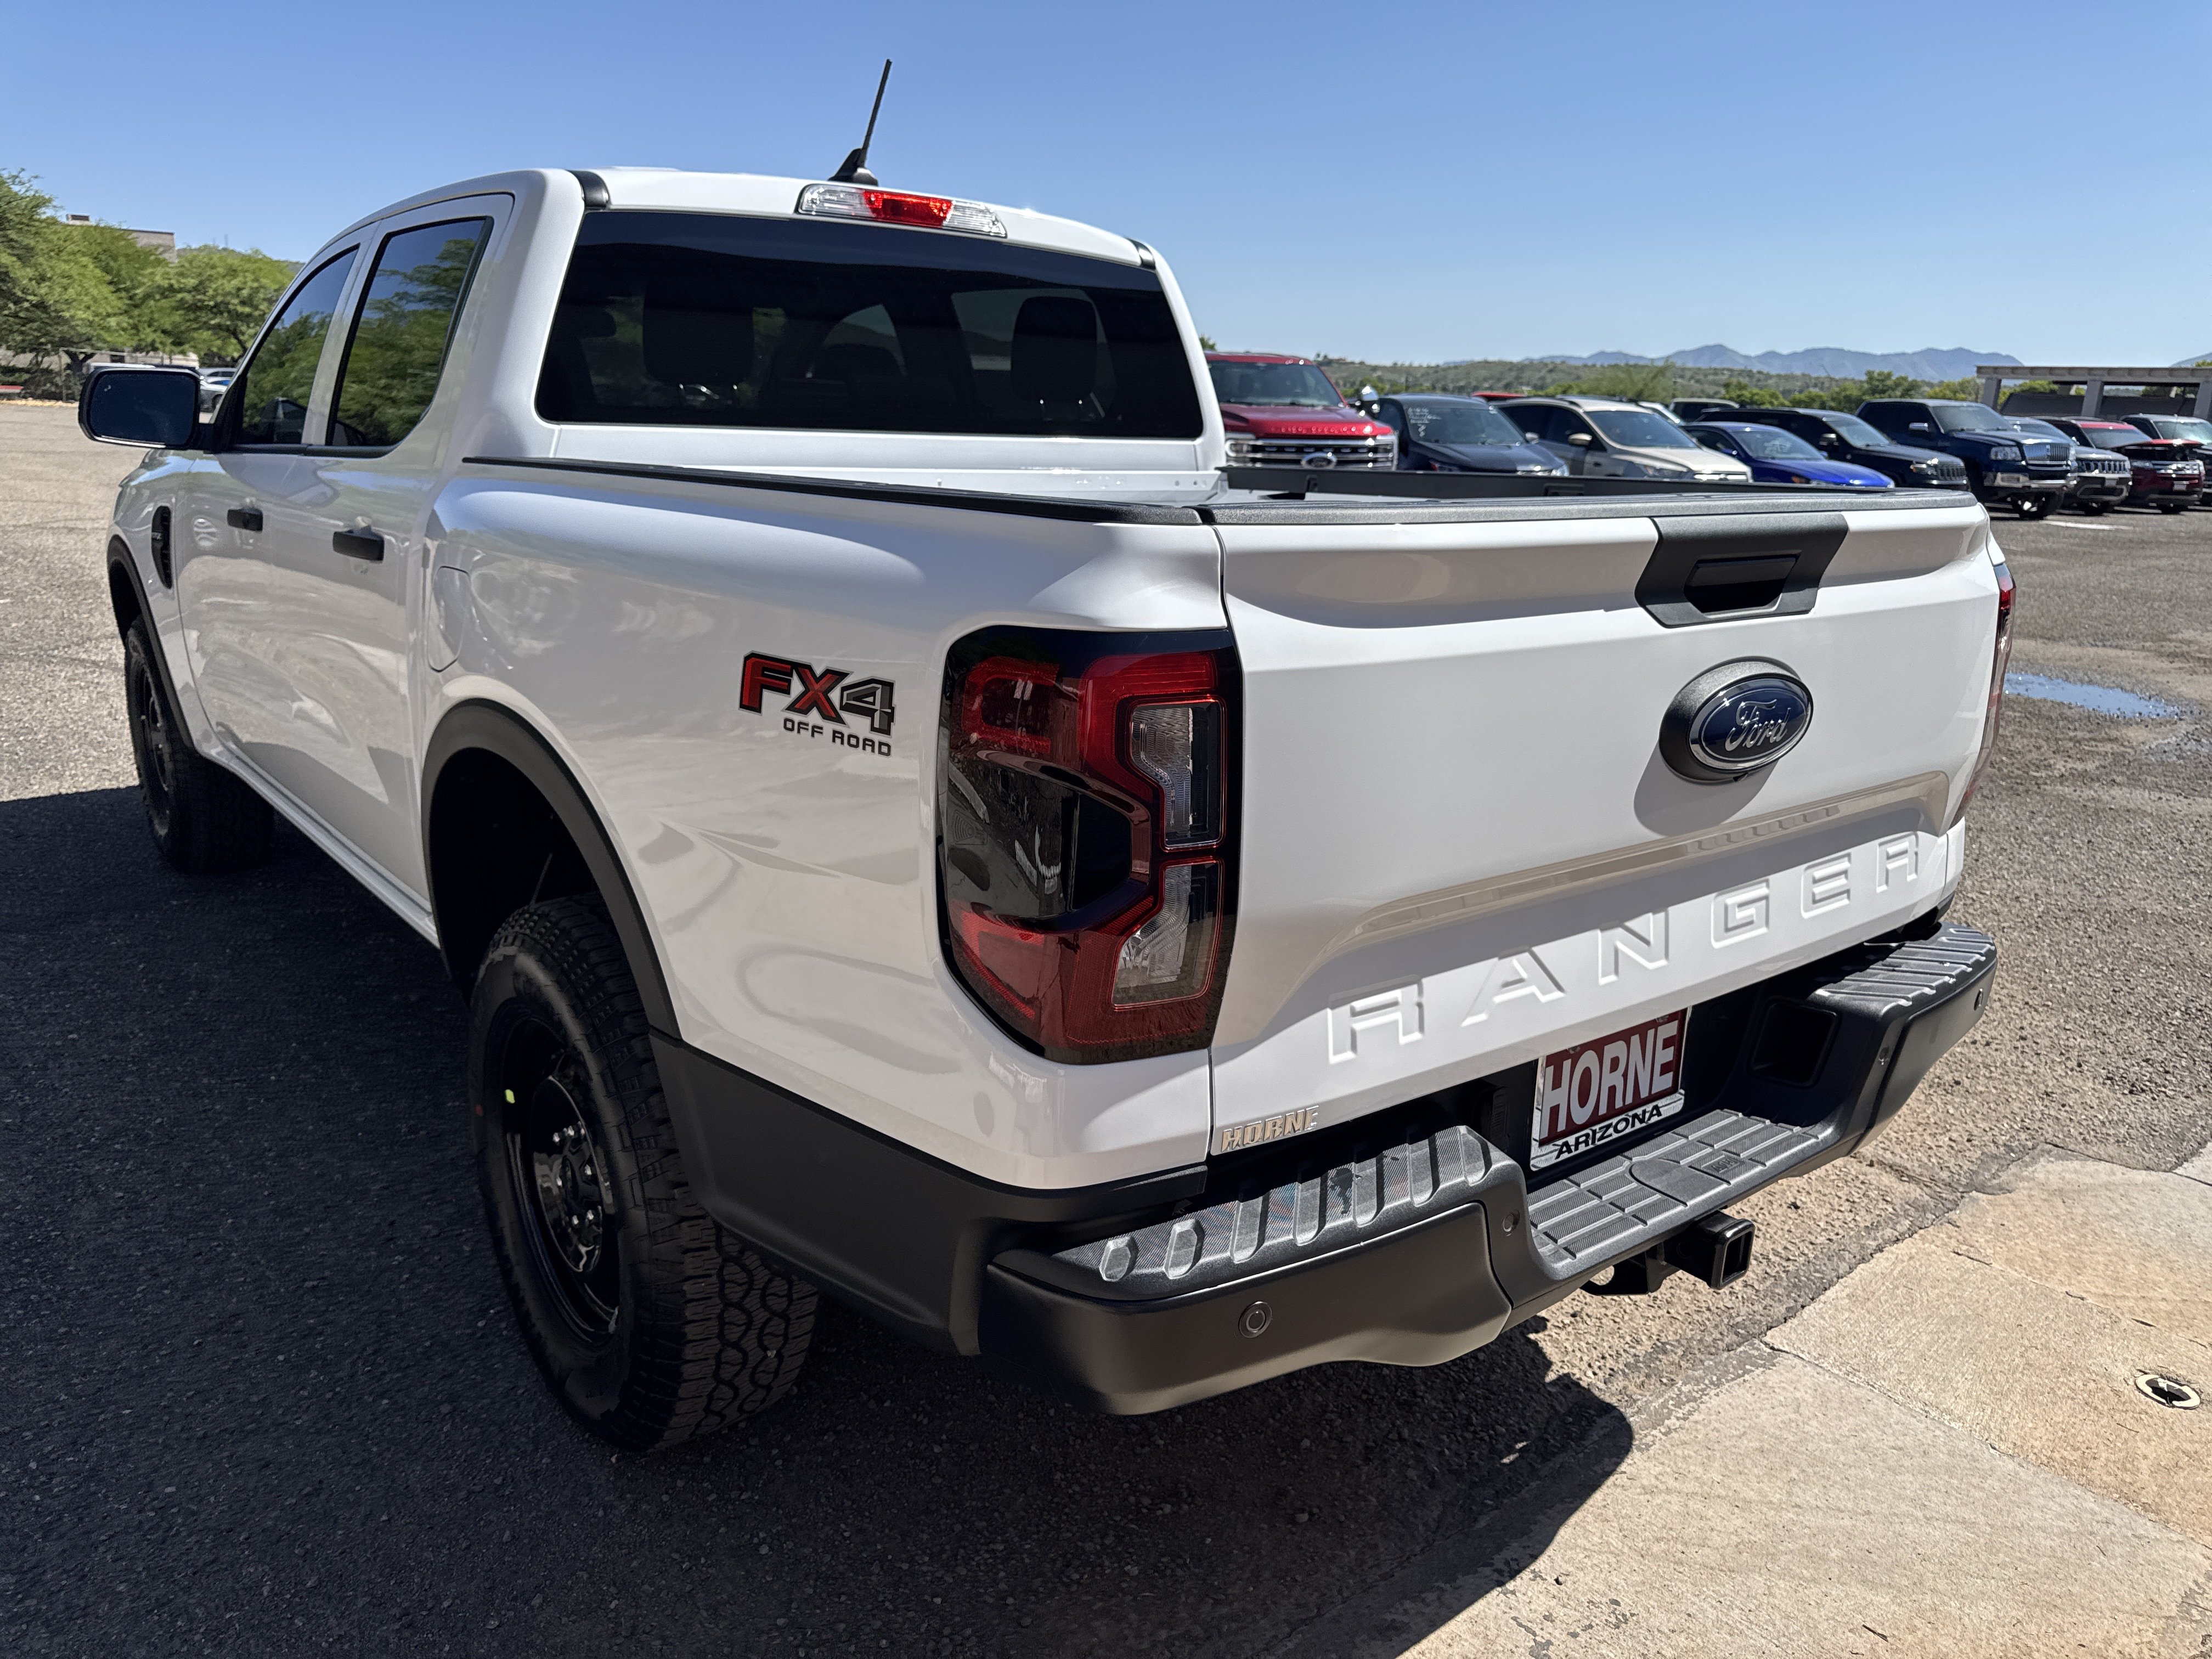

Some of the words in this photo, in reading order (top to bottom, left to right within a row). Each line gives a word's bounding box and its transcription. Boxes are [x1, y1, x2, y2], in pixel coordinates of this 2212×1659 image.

[740, 651, 895, 738] FX4
[783, 718, 823, 738] OFF
[832, 730, 891, 757] ROAD
[1725, 699, 1791, 751] Ford
[1328, 831, 1919, 1064] RANGER
[1539, 1020, 1679, 1139] HORNE
[1221, 1105, 1319, 1153] HORNE
[1555, 1104, 1662, 1160] ARIZONA
